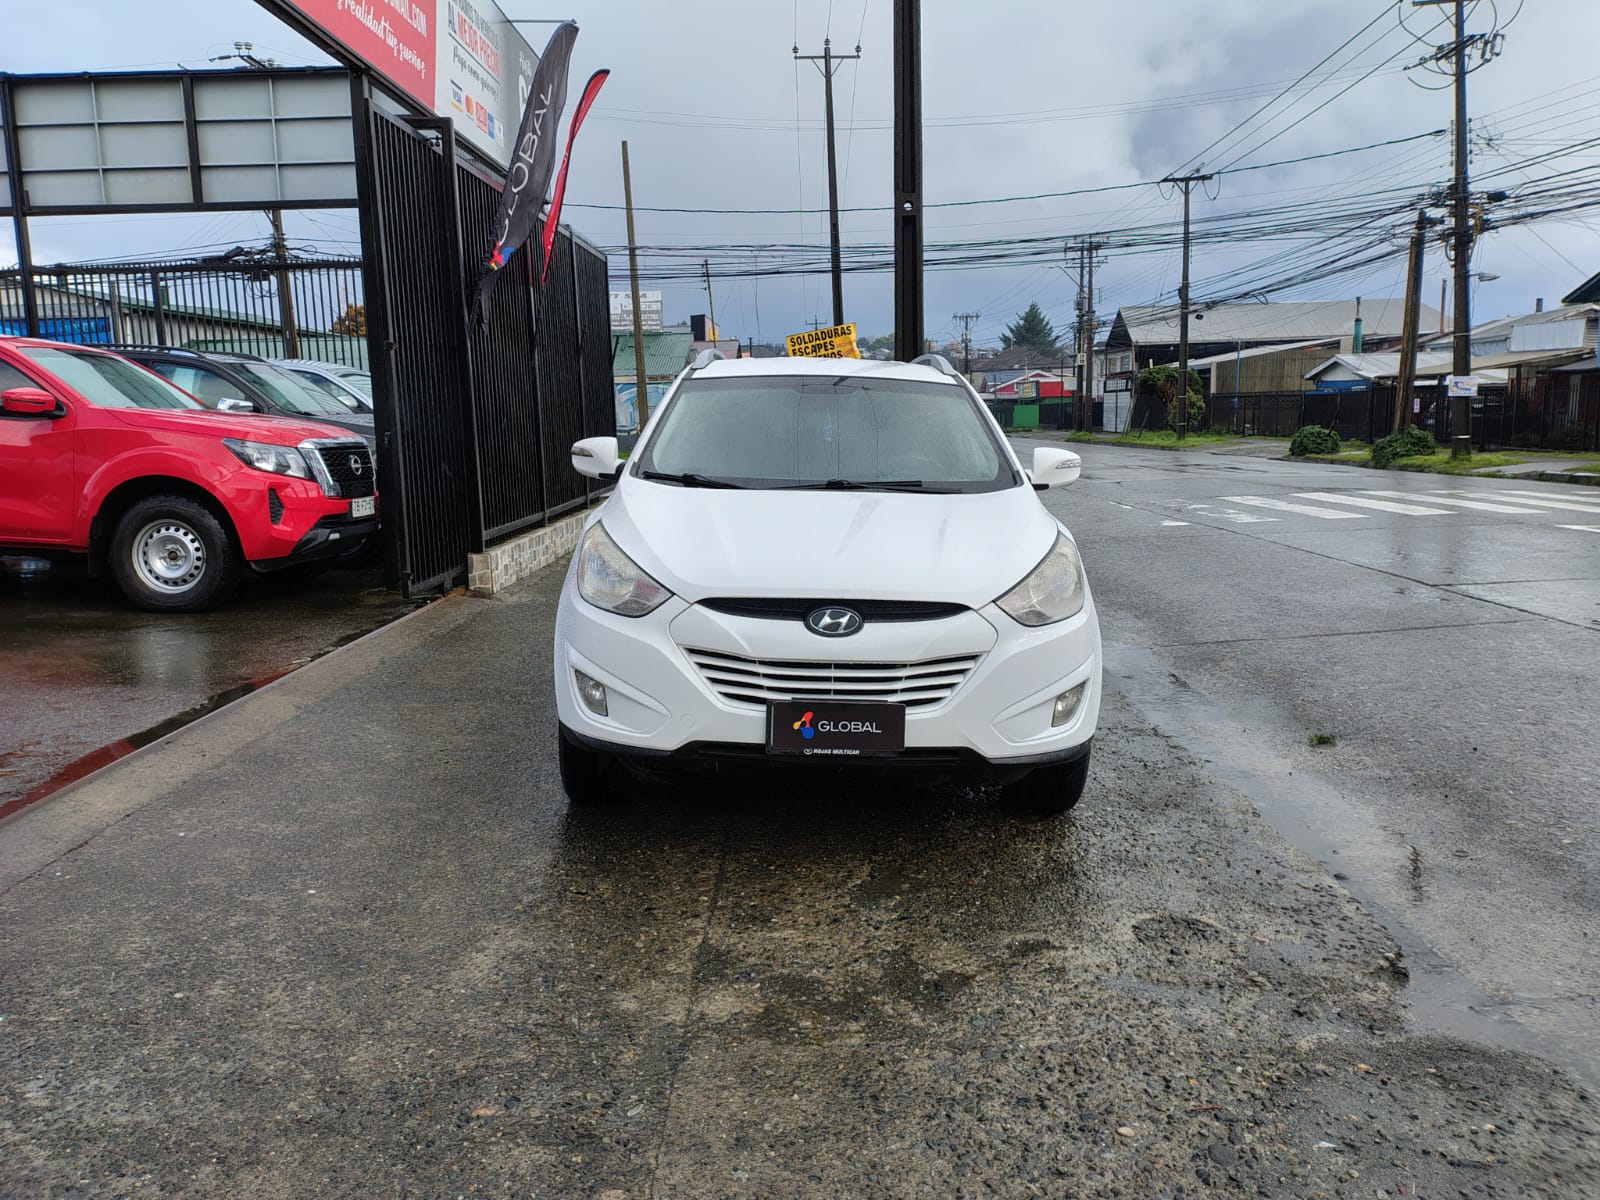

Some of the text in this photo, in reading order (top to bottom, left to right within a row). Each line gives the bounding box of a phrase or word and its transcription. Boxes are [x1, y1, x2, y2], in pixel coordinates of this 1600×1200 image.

[790, 325, 853, 348] SOLDADURAS
[791, 340, 836, 357] ESCAPES
[818, 720, 882, 733] GLOBAL
